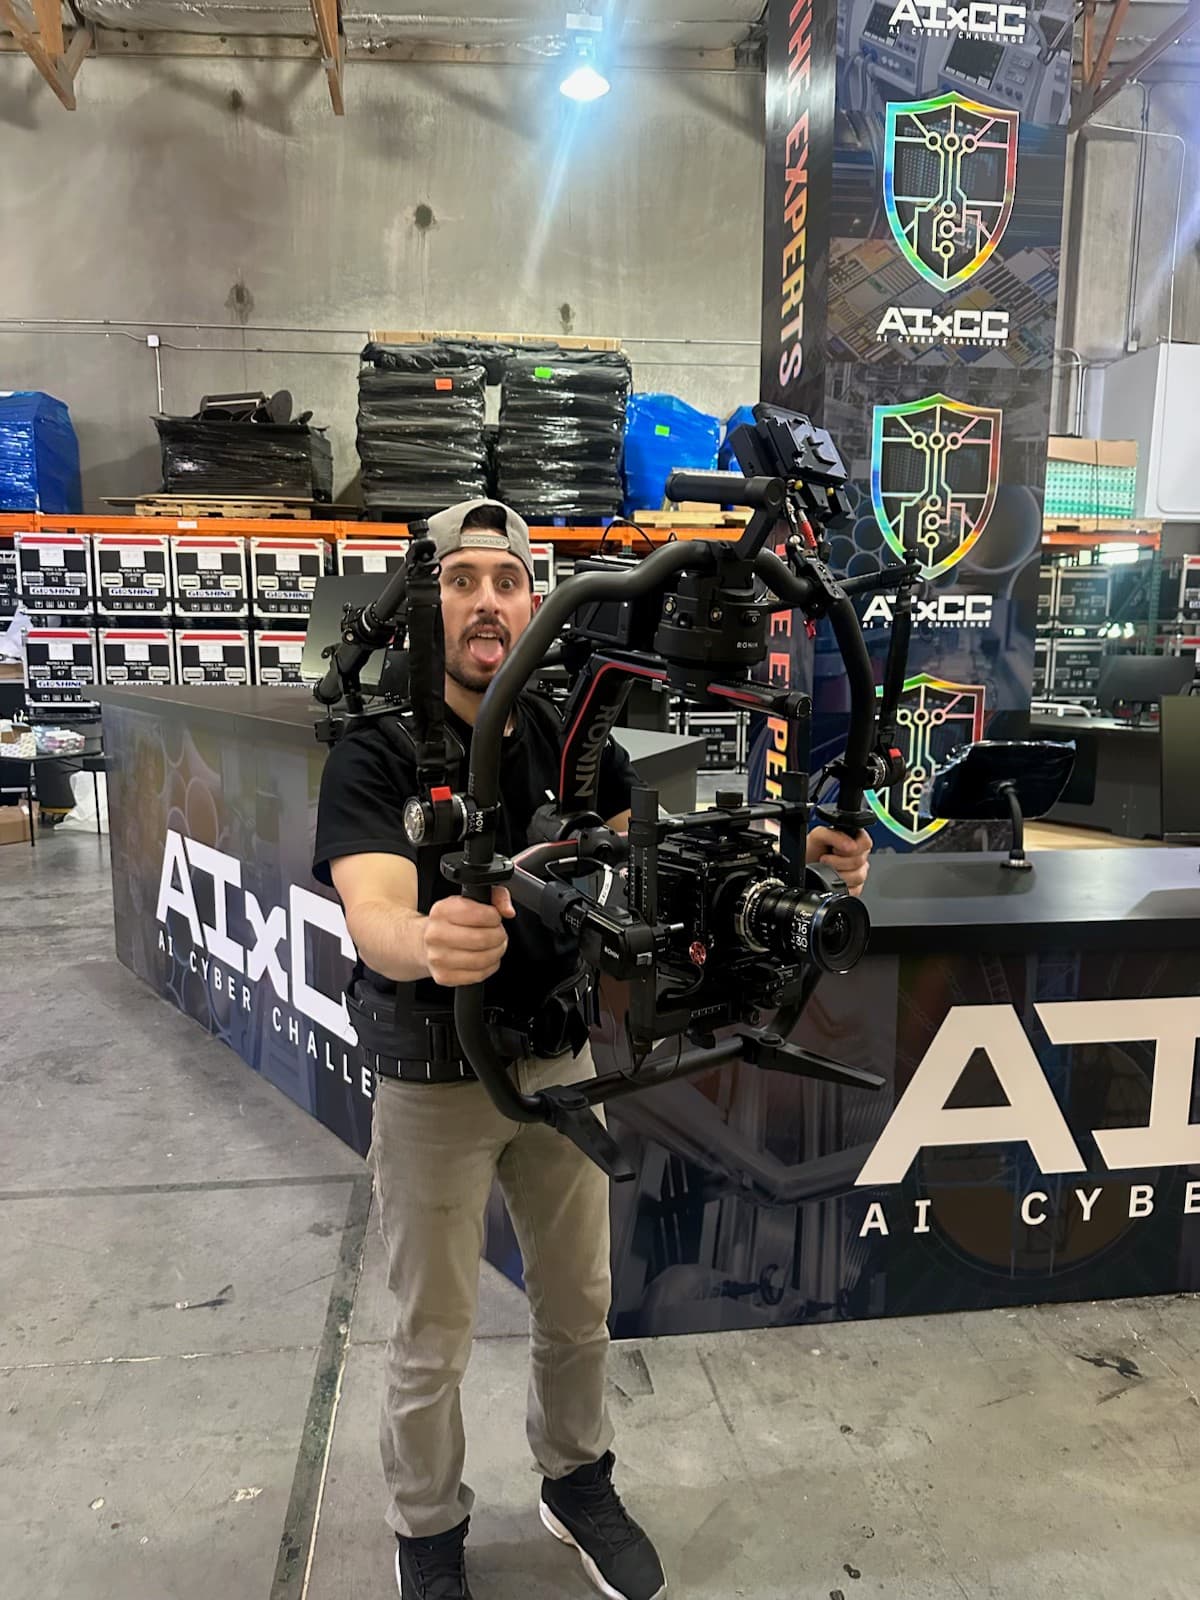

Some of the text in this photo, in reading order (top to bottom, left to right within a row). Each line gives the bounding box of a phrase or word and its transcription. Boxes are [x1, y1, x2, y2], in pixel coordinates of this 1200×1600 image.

[888, 0, 1027, 35] AIxCC
[911, 28, 948, 38] CYBER
[958, 32, 1025, 43] CHALLENGE
[779, 107, 809, 387] EXPERTS
[876, 306, 1010, 339] AIxCC
[898, 336, 934, 344] CYBER
[943, 338, 1007, 347] CHALLENGE
[574, 704, 620, 797] RONIN
[796, 936, 808, 948] 30
[798, 922, 808, 934] 16
[158, 929, 374, 1098] AI CYBER CHALLE
[859, 1199, 932, 1237] AI
